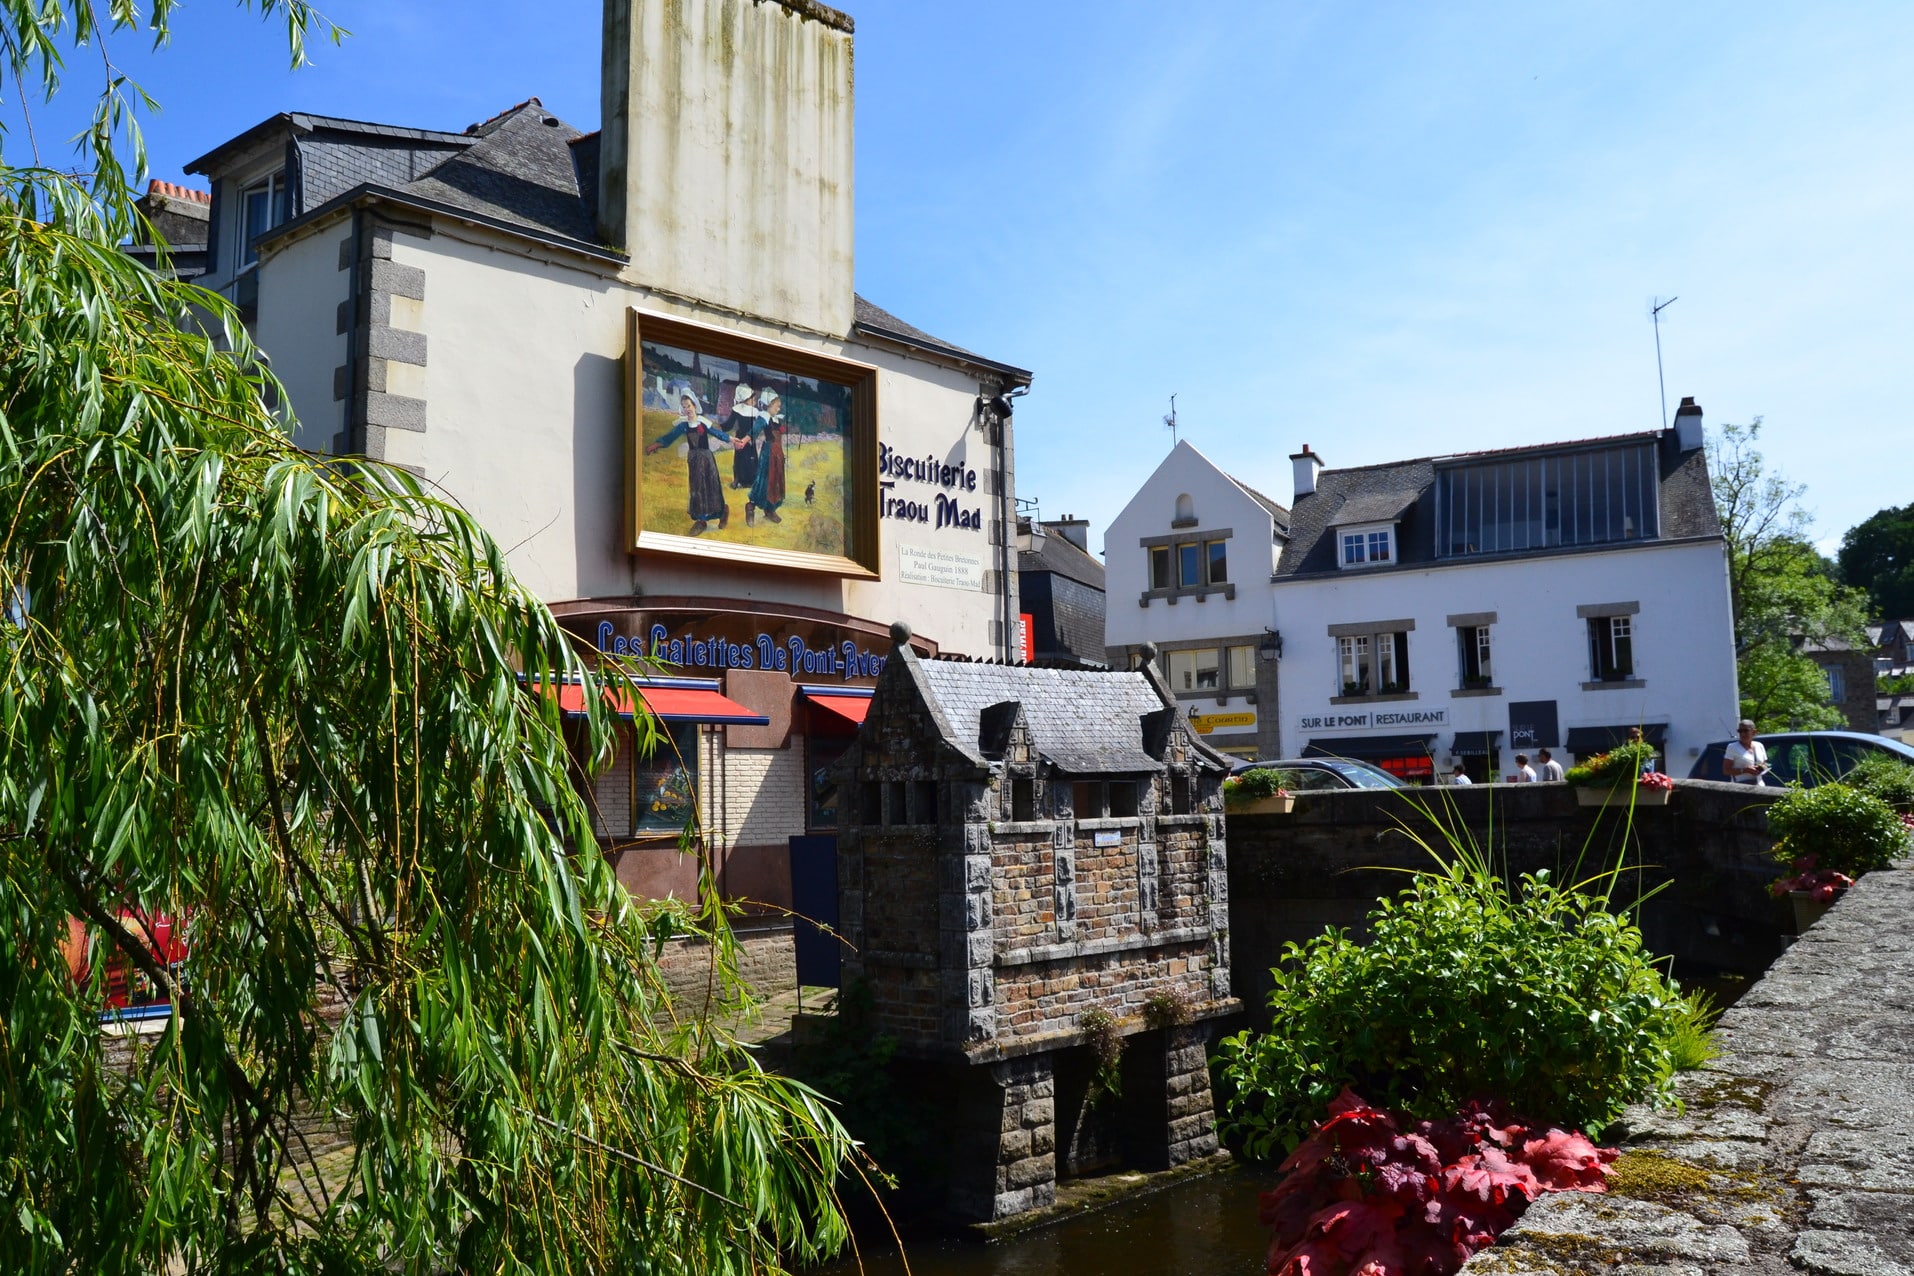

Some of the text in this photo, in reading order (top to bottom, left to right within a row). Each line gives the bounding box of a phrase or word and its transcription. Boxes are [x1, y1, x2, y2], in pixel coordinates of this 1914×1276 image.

[879, 441, 976, 491] Biscuiterie
[880, 481, 982, 531] Traou Mad
[901, 547, 909, 556] La
[910, 548, 926, 558] Ronde
[927, 551, 936, 560] des
[913, 561, 969, 576] Paul Gauguin 1888
[930, 575, 955, 586] Biscuiterie
[597, 620, 643, 662] Les
[650, 623, 754, 669] Galettes
[756, 633, 787, 671] De
[1301, 711, 1445, 729] SUR LE PONT RESTAURANT
[1513, 730, 1535, 742] PONT
